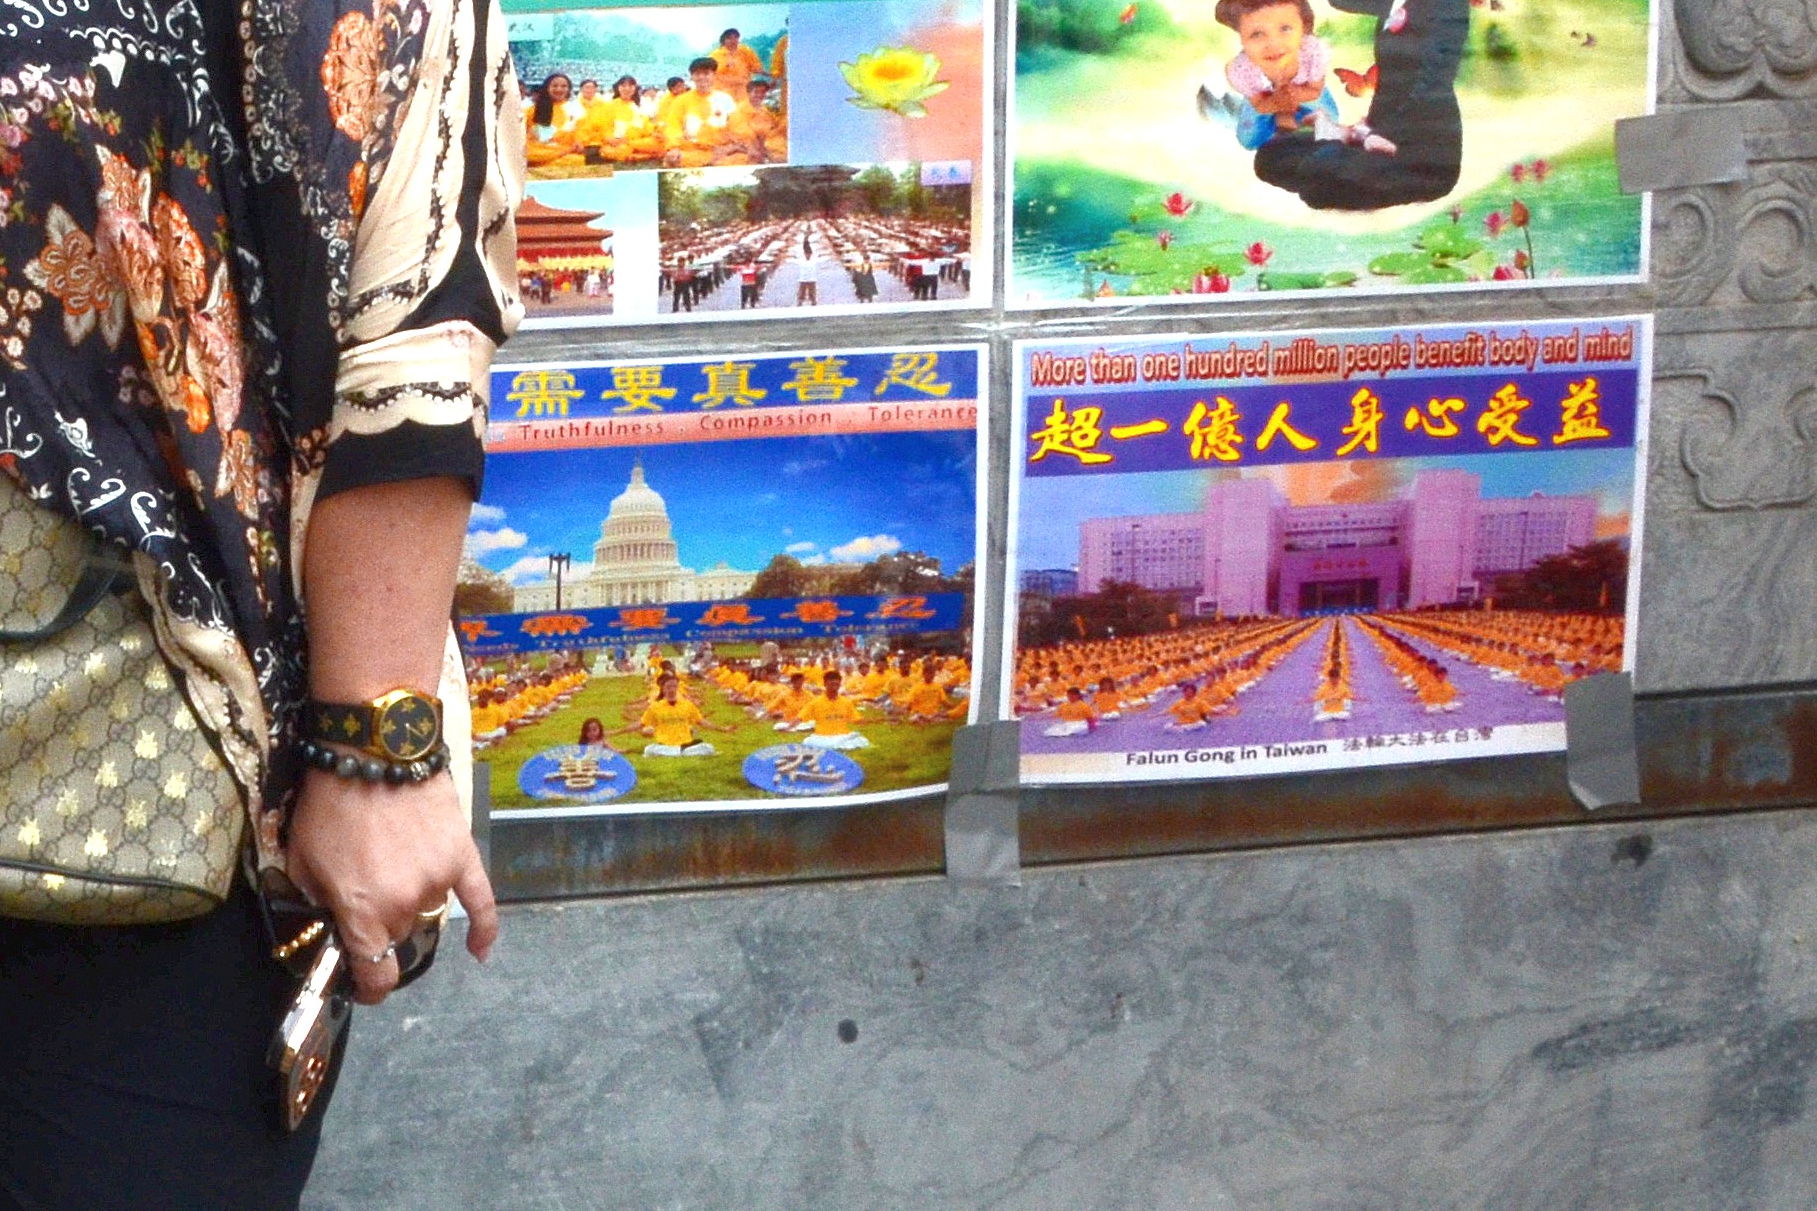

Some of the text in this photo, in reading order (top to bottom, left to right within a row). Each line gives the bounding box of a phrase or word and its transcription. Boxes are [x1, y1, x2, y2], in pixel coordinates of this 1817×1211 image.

[1030, 326, 1632, 386] More than one hundred million people benefit body and mind
[519, 421, 665, 441] Truthfulness
[700, 409, 833, 432] Compassion
[867, 404, 978, 424] Tolerance
[1029, 376, 1610, 464] 超一億人身心受益
[1126, 742, 1327, 766] Falun Gong in Taiwan
